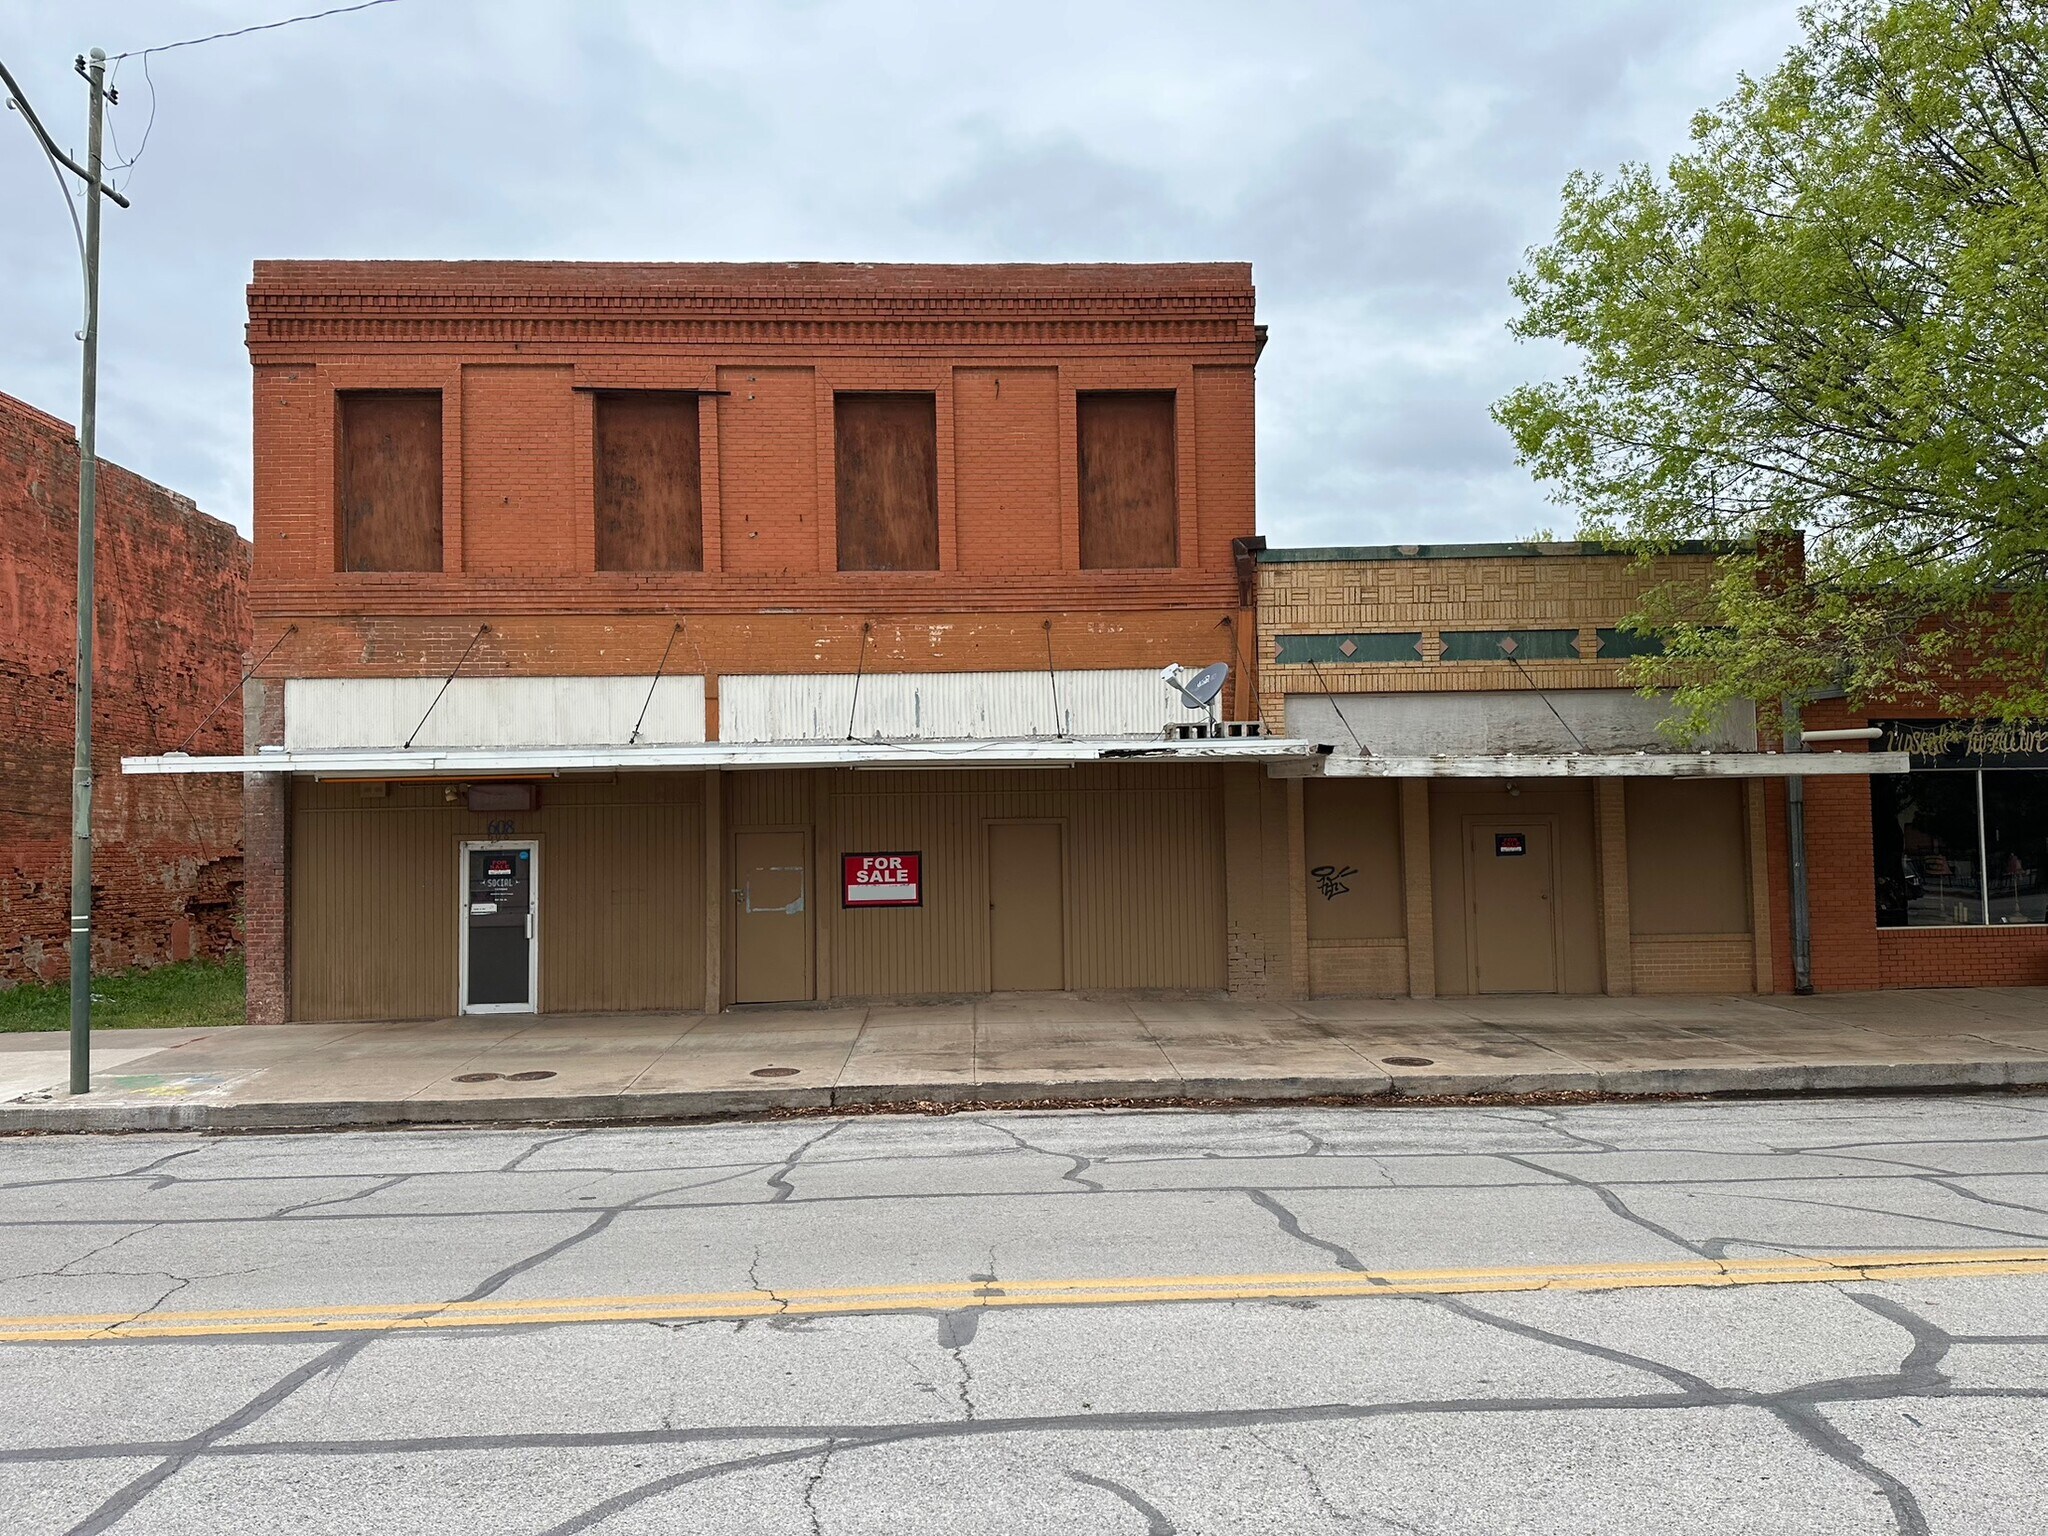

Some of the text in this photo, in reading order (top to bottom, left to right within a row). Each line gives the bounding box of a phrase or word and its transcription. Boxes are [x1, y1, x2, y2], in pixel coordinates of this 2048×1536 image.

[488, 819, 515, 835] 608
[863, 857, 902, 870] FOR
[487, 878, 513, 887] SOCIAL
[856, 869, 909, 883] SALE
